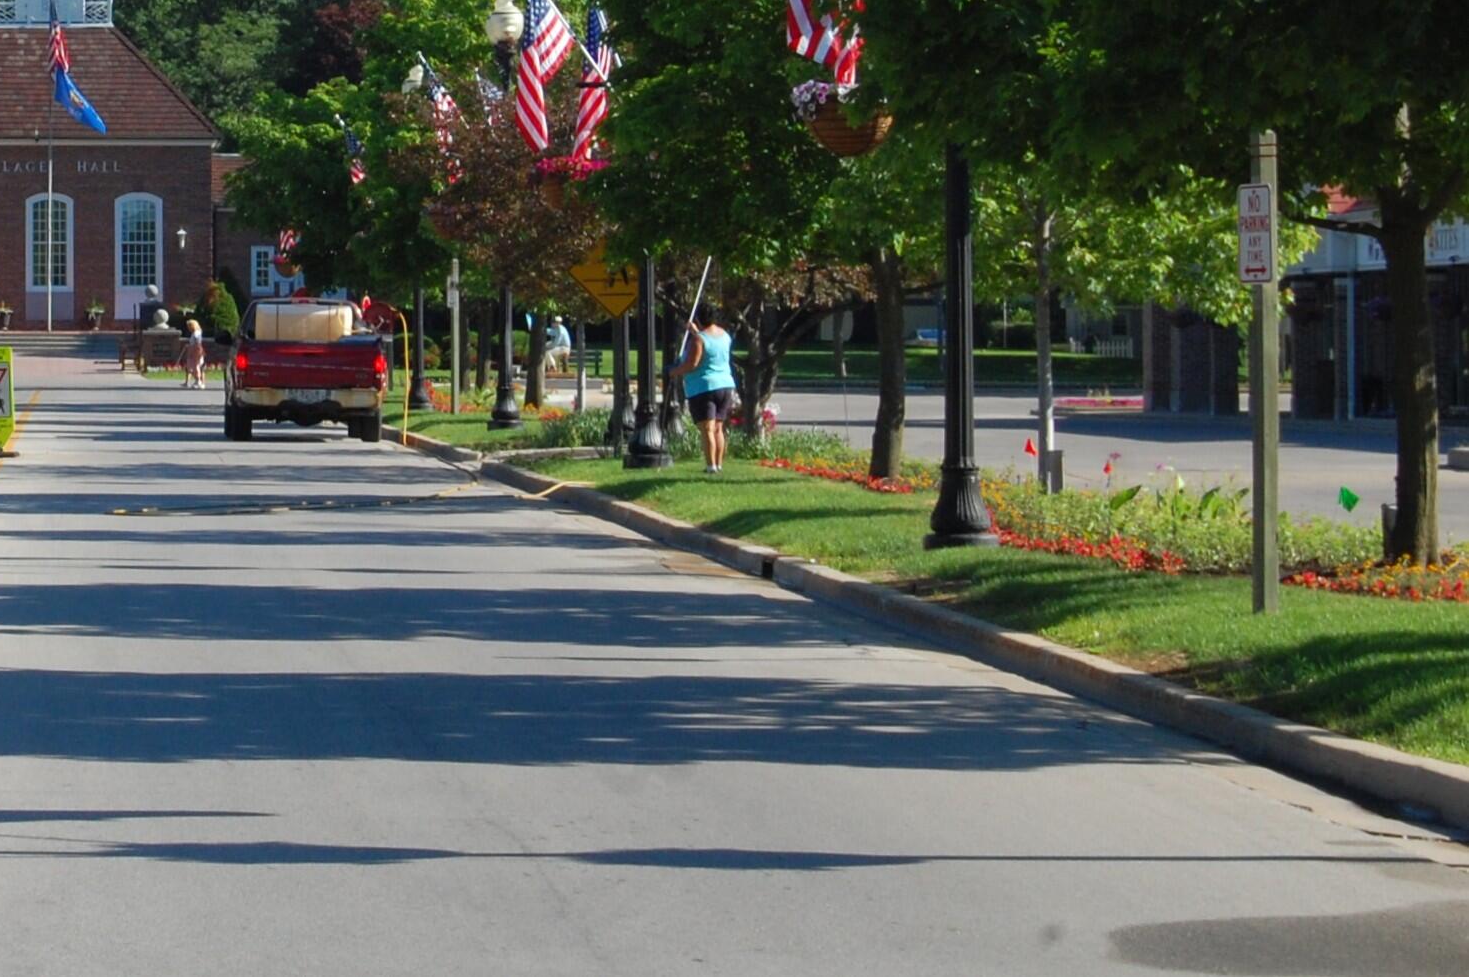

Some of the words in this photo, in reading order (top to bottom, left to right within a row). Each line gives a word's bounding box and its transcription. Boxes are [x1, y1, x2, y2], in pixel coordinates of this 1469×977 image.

[77, 160, 121, 173] HALL
[1247, 194, 1260, 213] NO
[1240, 215, 1269, 232] PARKING
[1248, 236, 1262, 248] ANY
[1247, 250, 1263, 262] TIME
